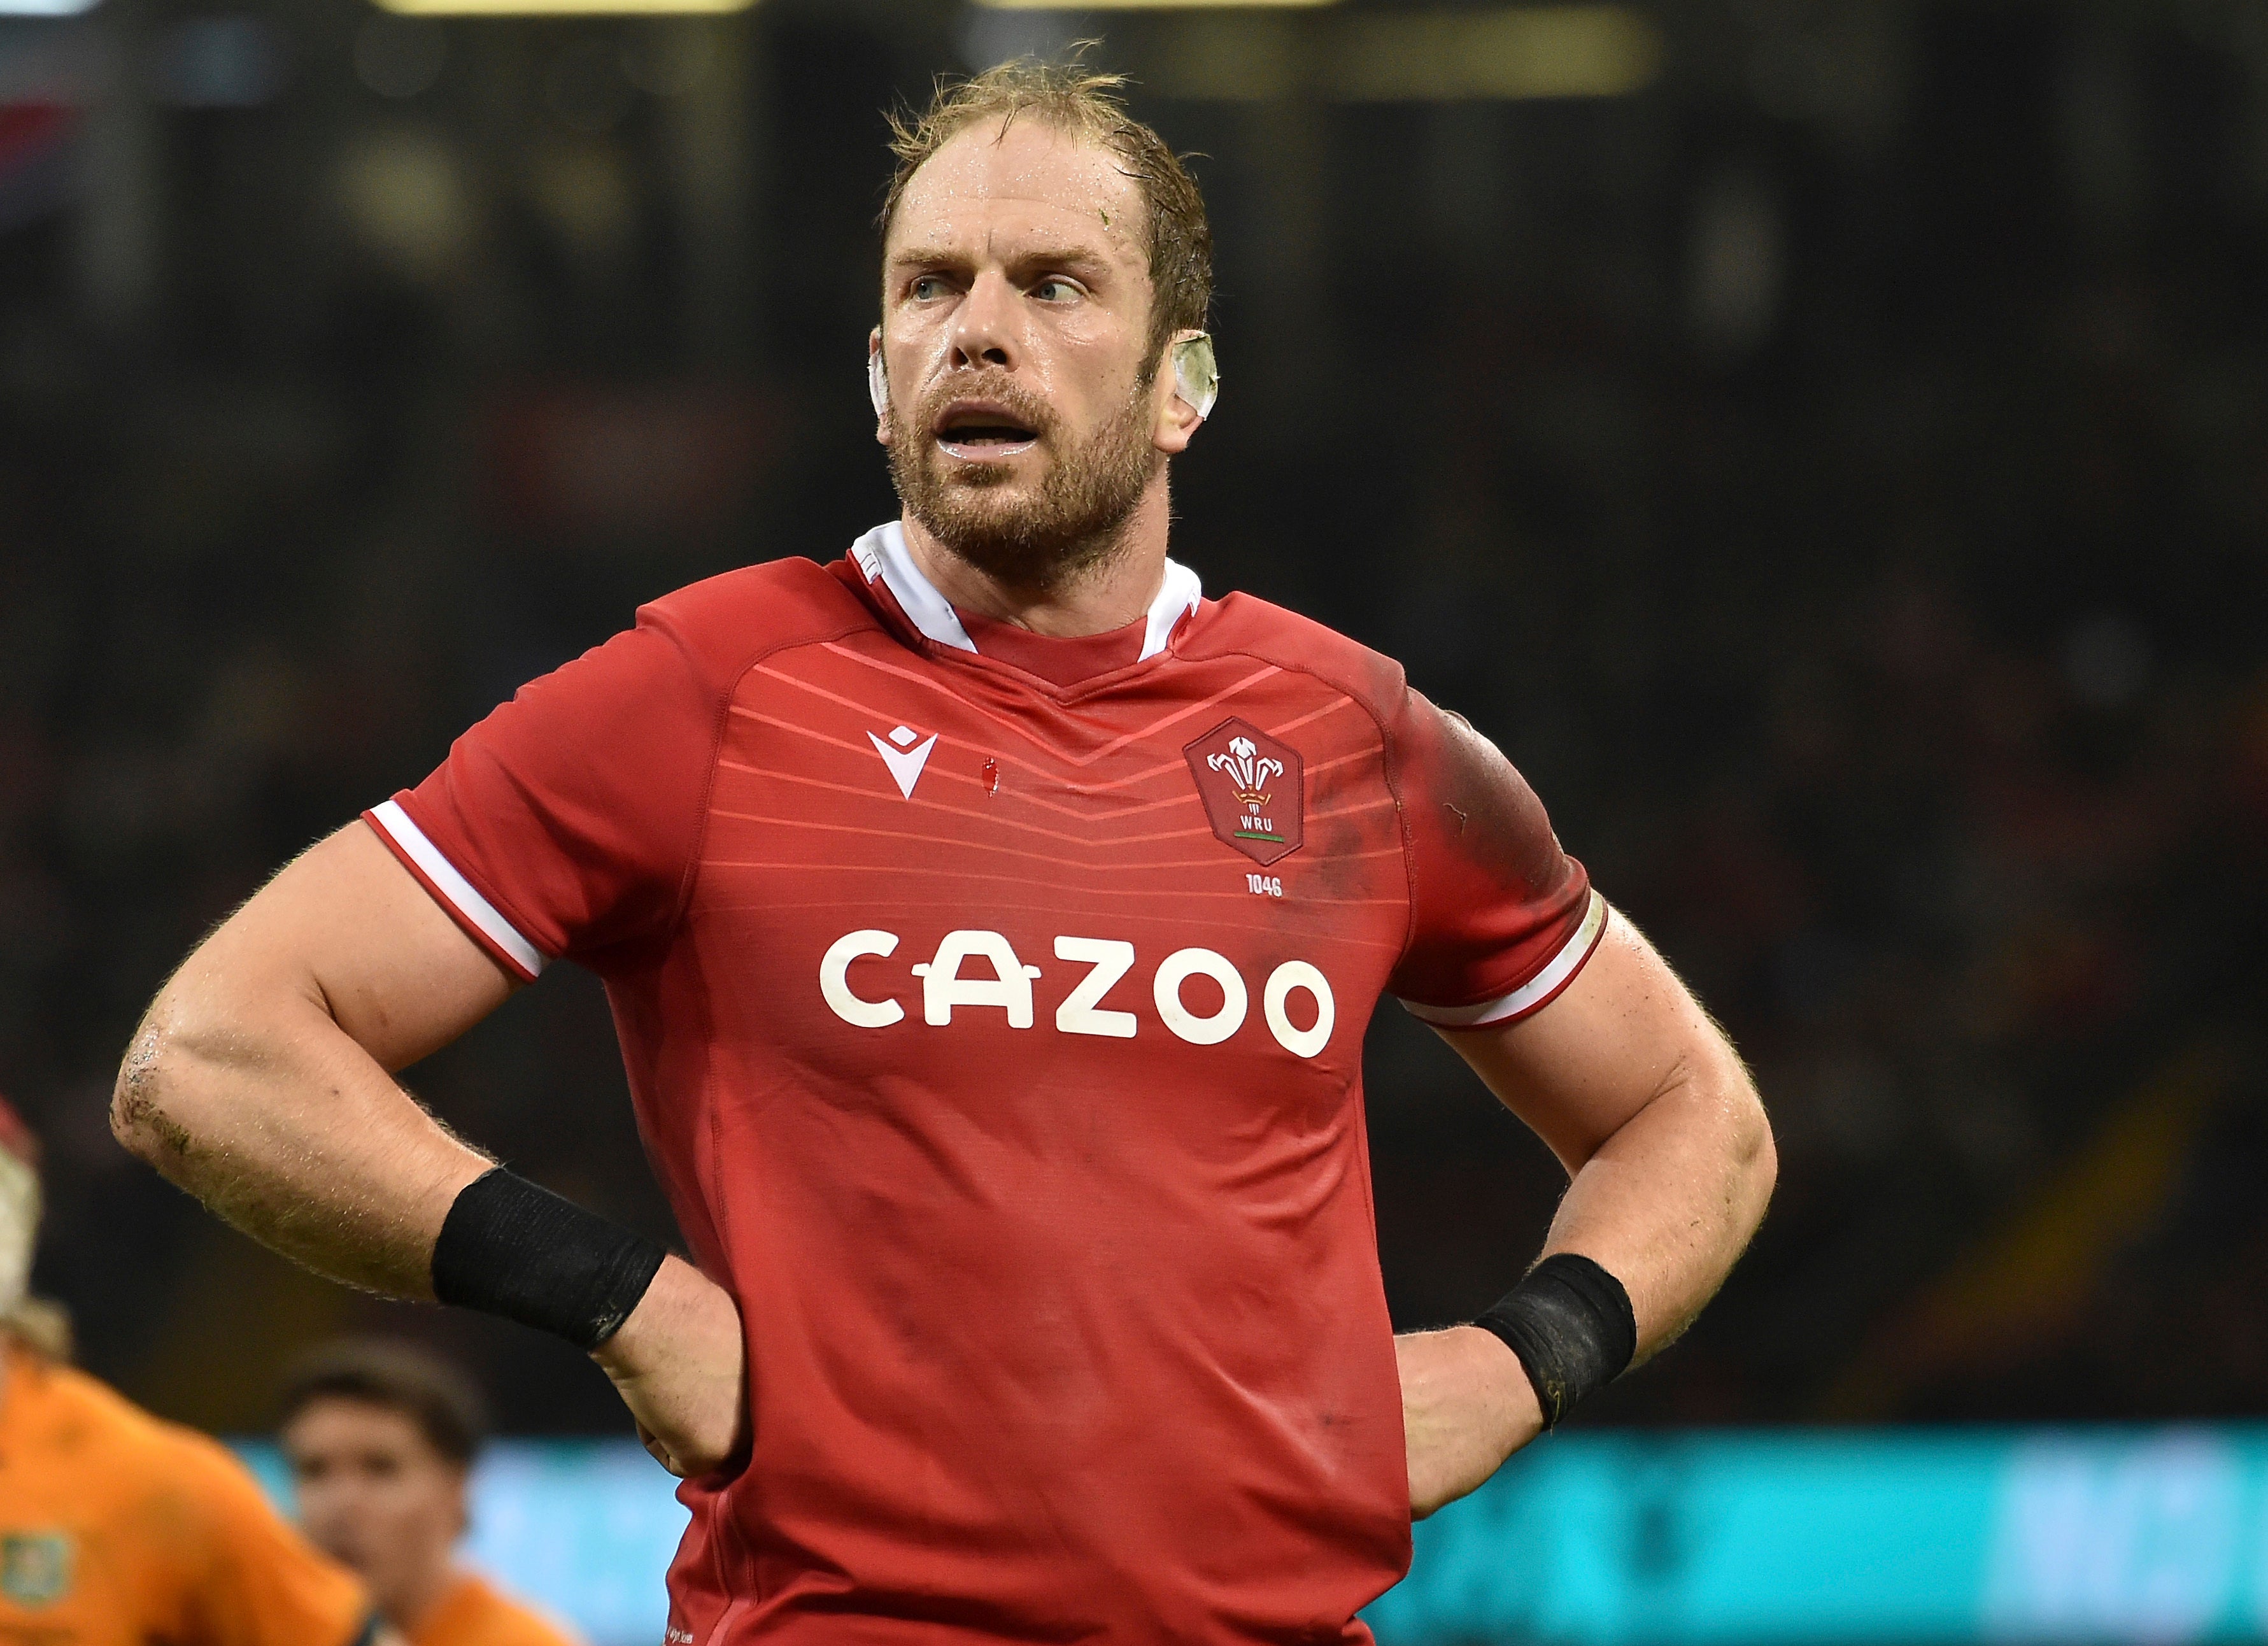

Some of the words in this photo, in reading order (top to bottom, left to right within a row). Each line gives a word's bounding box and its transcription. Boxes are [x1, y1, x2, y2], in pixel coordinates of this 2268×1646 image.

[1240, 816, 1272, 832] WRU
[1245, 874, 1283, 897] 1046
[819, 929, 1335, 1058] CAZOO
